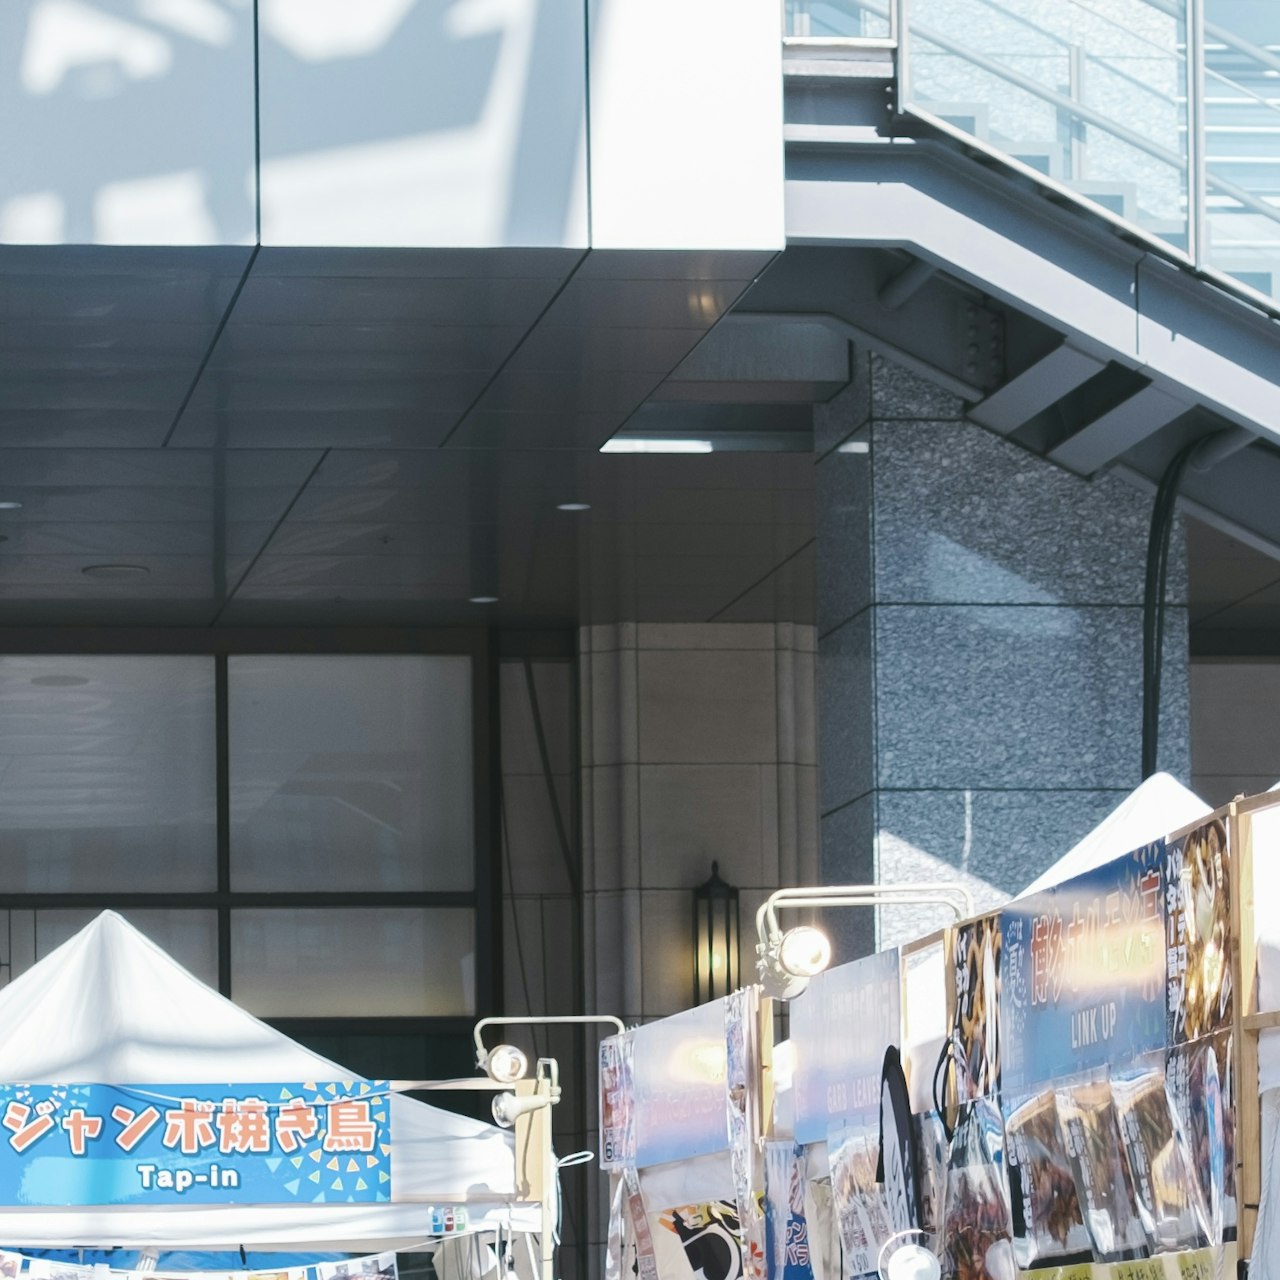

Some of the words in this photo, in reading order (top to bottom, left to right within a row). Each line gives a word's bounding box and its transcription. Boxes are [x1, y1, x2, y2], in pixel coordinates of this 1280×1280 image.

[1071, 1006, 1098, 1050] LINK
[1101, 1001, 1117, 1038] UP
[3, 1098, 378, 1154] ジャンボ焼き鳥
[137, 1165, 239, 1192] Tap-in
